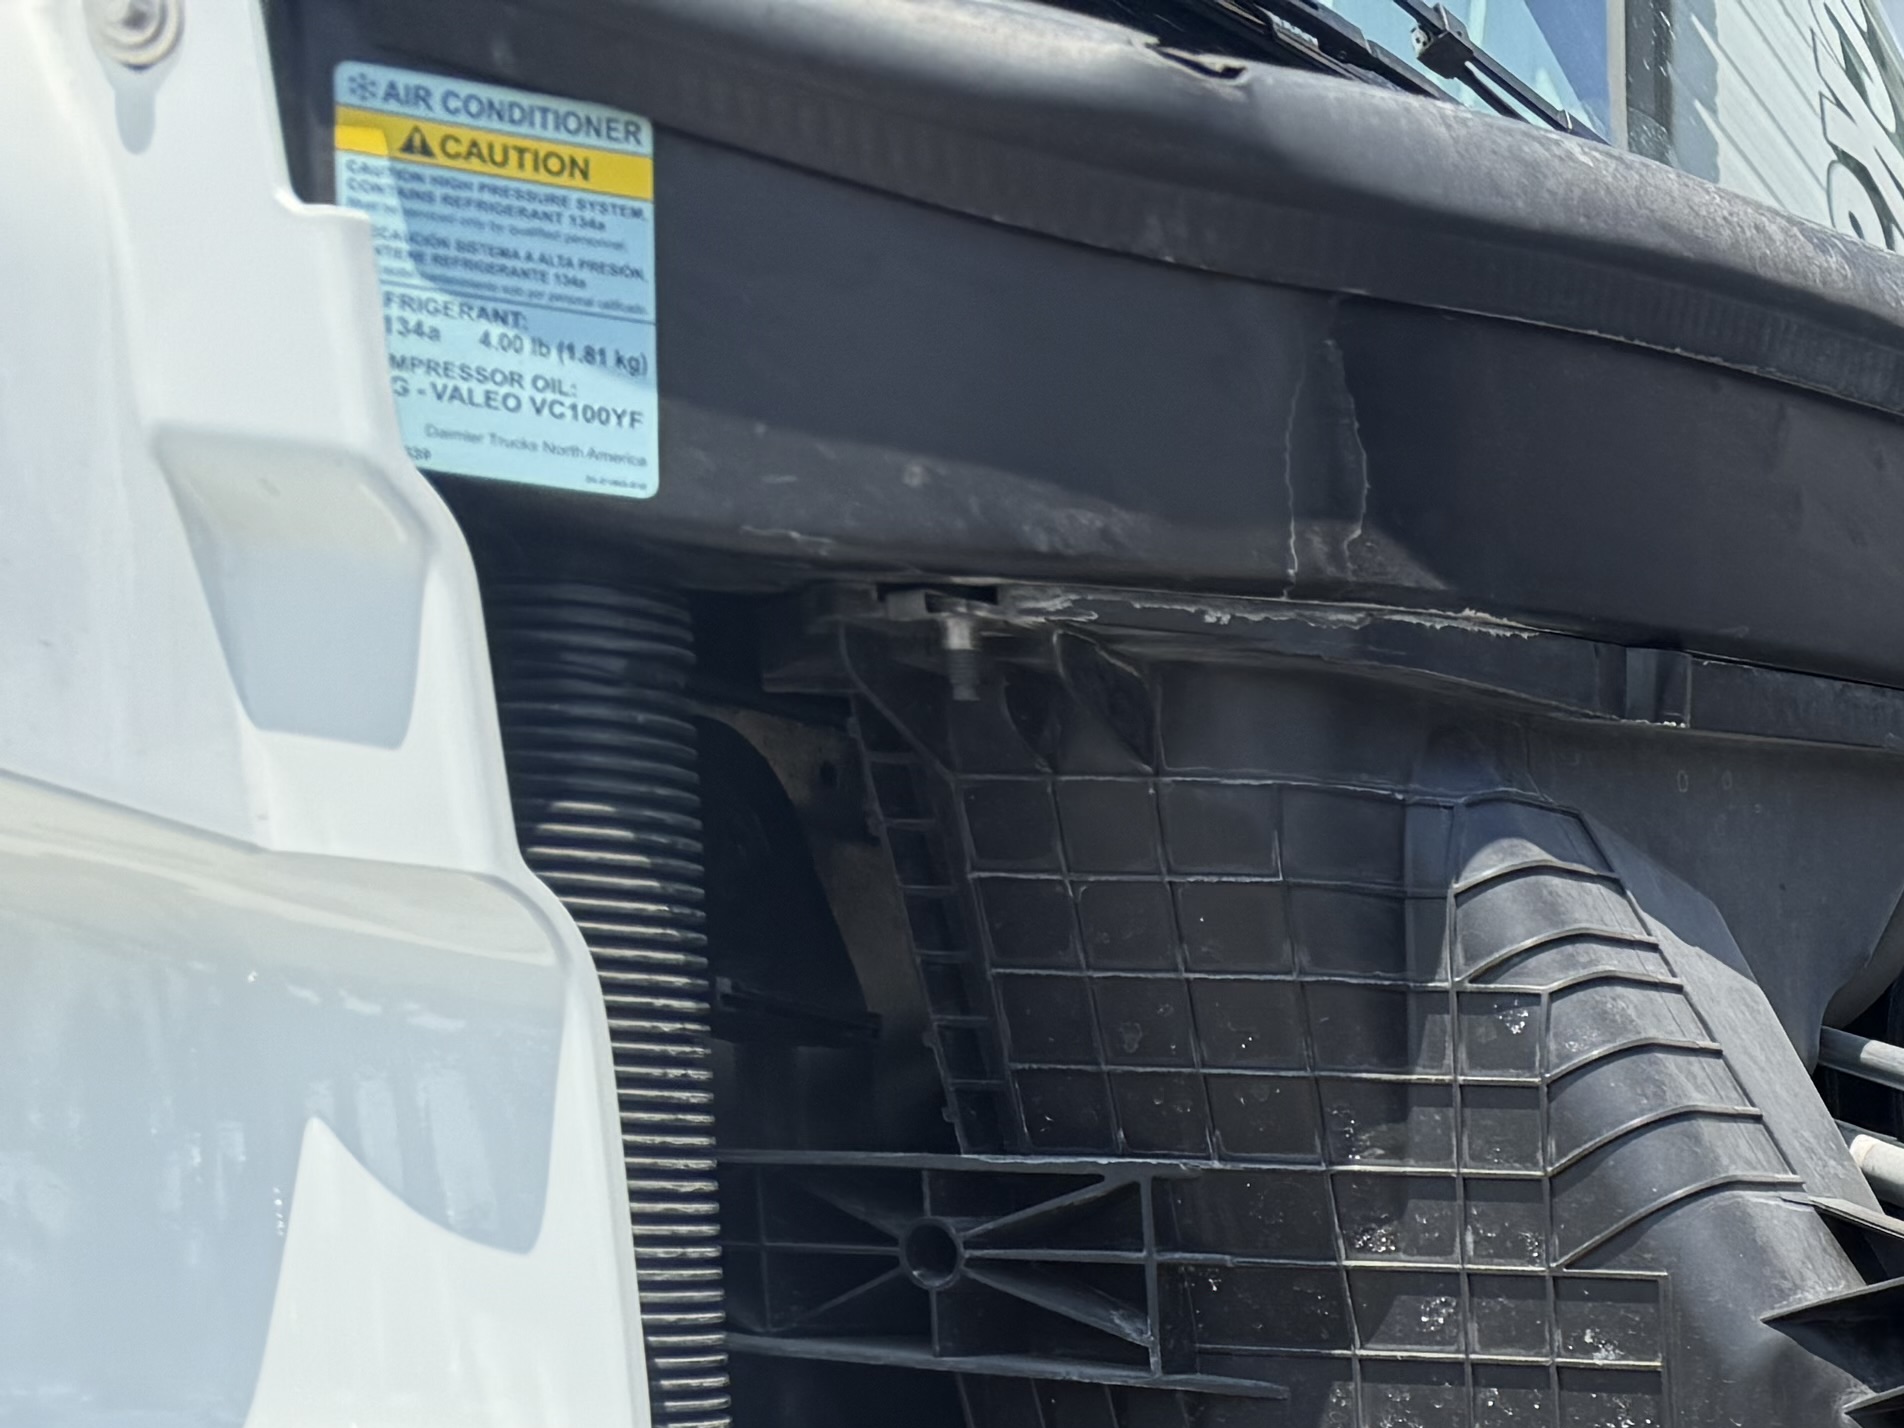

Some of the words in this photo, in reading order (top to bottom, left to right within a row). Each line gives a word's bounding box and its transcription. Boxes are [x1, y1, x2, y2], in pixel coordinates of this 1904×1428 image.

[383, 79, 434, 113] AIR
[442, 89, 643, 146] CONDITIONER
[439, 134, 592, 182] CAUTION
[384, 290, 528, 331] FRIGERANT:
[385, 315, 442, 343] 134a
[479, 328, 524, 354] 4.00
[530, 337, 551, 358] lb
[556, 340, 608, 366] (1.81
[615, 349, 648, 377] kg)
[388, 352, 525, 390] MPRESSOR
[531, 374, 577, 398] OIL:
[429, 380, 522, 414] VALEO
[529, 395, 644, 430] VC100YF
[423, 421, 484, 444] Daimler
[489, 431, 539, 453] Trucks
[541, 440, 585, 459] North
[585, 447, 648, 467] America
